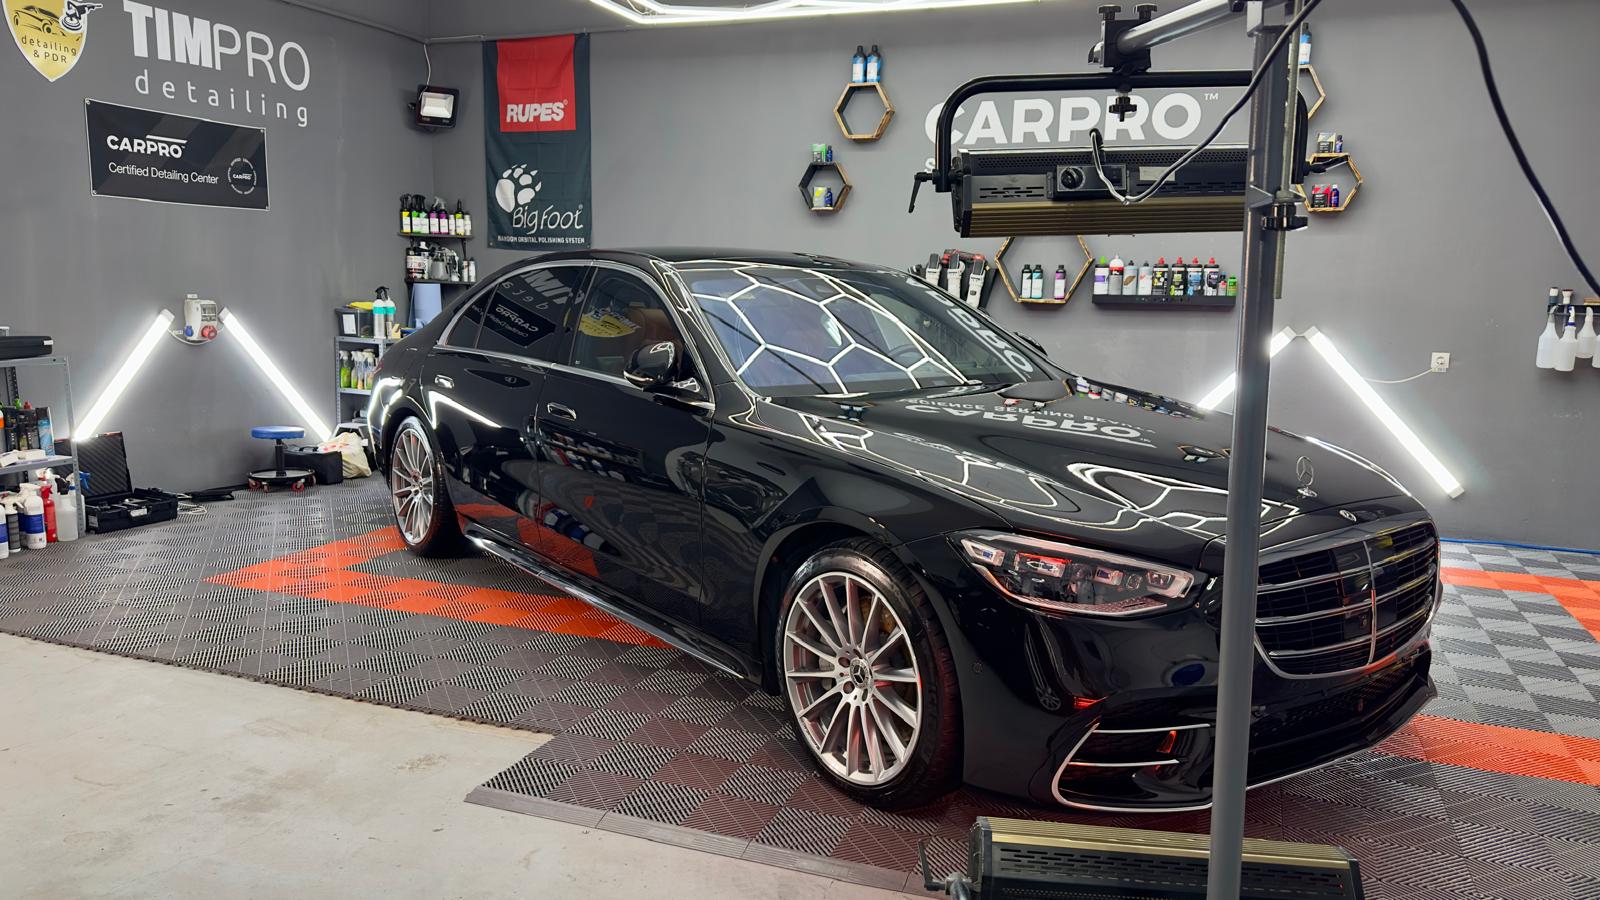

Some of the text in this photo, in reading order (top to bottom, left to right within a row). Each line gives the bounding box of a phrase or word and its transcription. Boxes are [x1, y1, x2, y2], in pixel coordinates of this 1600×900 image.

[21, 35, 77, 56] detailing
[33, 50, 67, 63] & PDR
[123, 0, 310, 91] TIMPRO
[135, 69, 308, 127] detailing
[506, 102, 565, 122] RUPES
[925, 92, 1201, 145] CARPRO
[106, 135, 183, 158] CARPRO
[108, 162, 219, 184] Certified Detailing Center
[538, 236, 565, 244] POLISHING
[565, 236, 585, 244] SYSTEM
